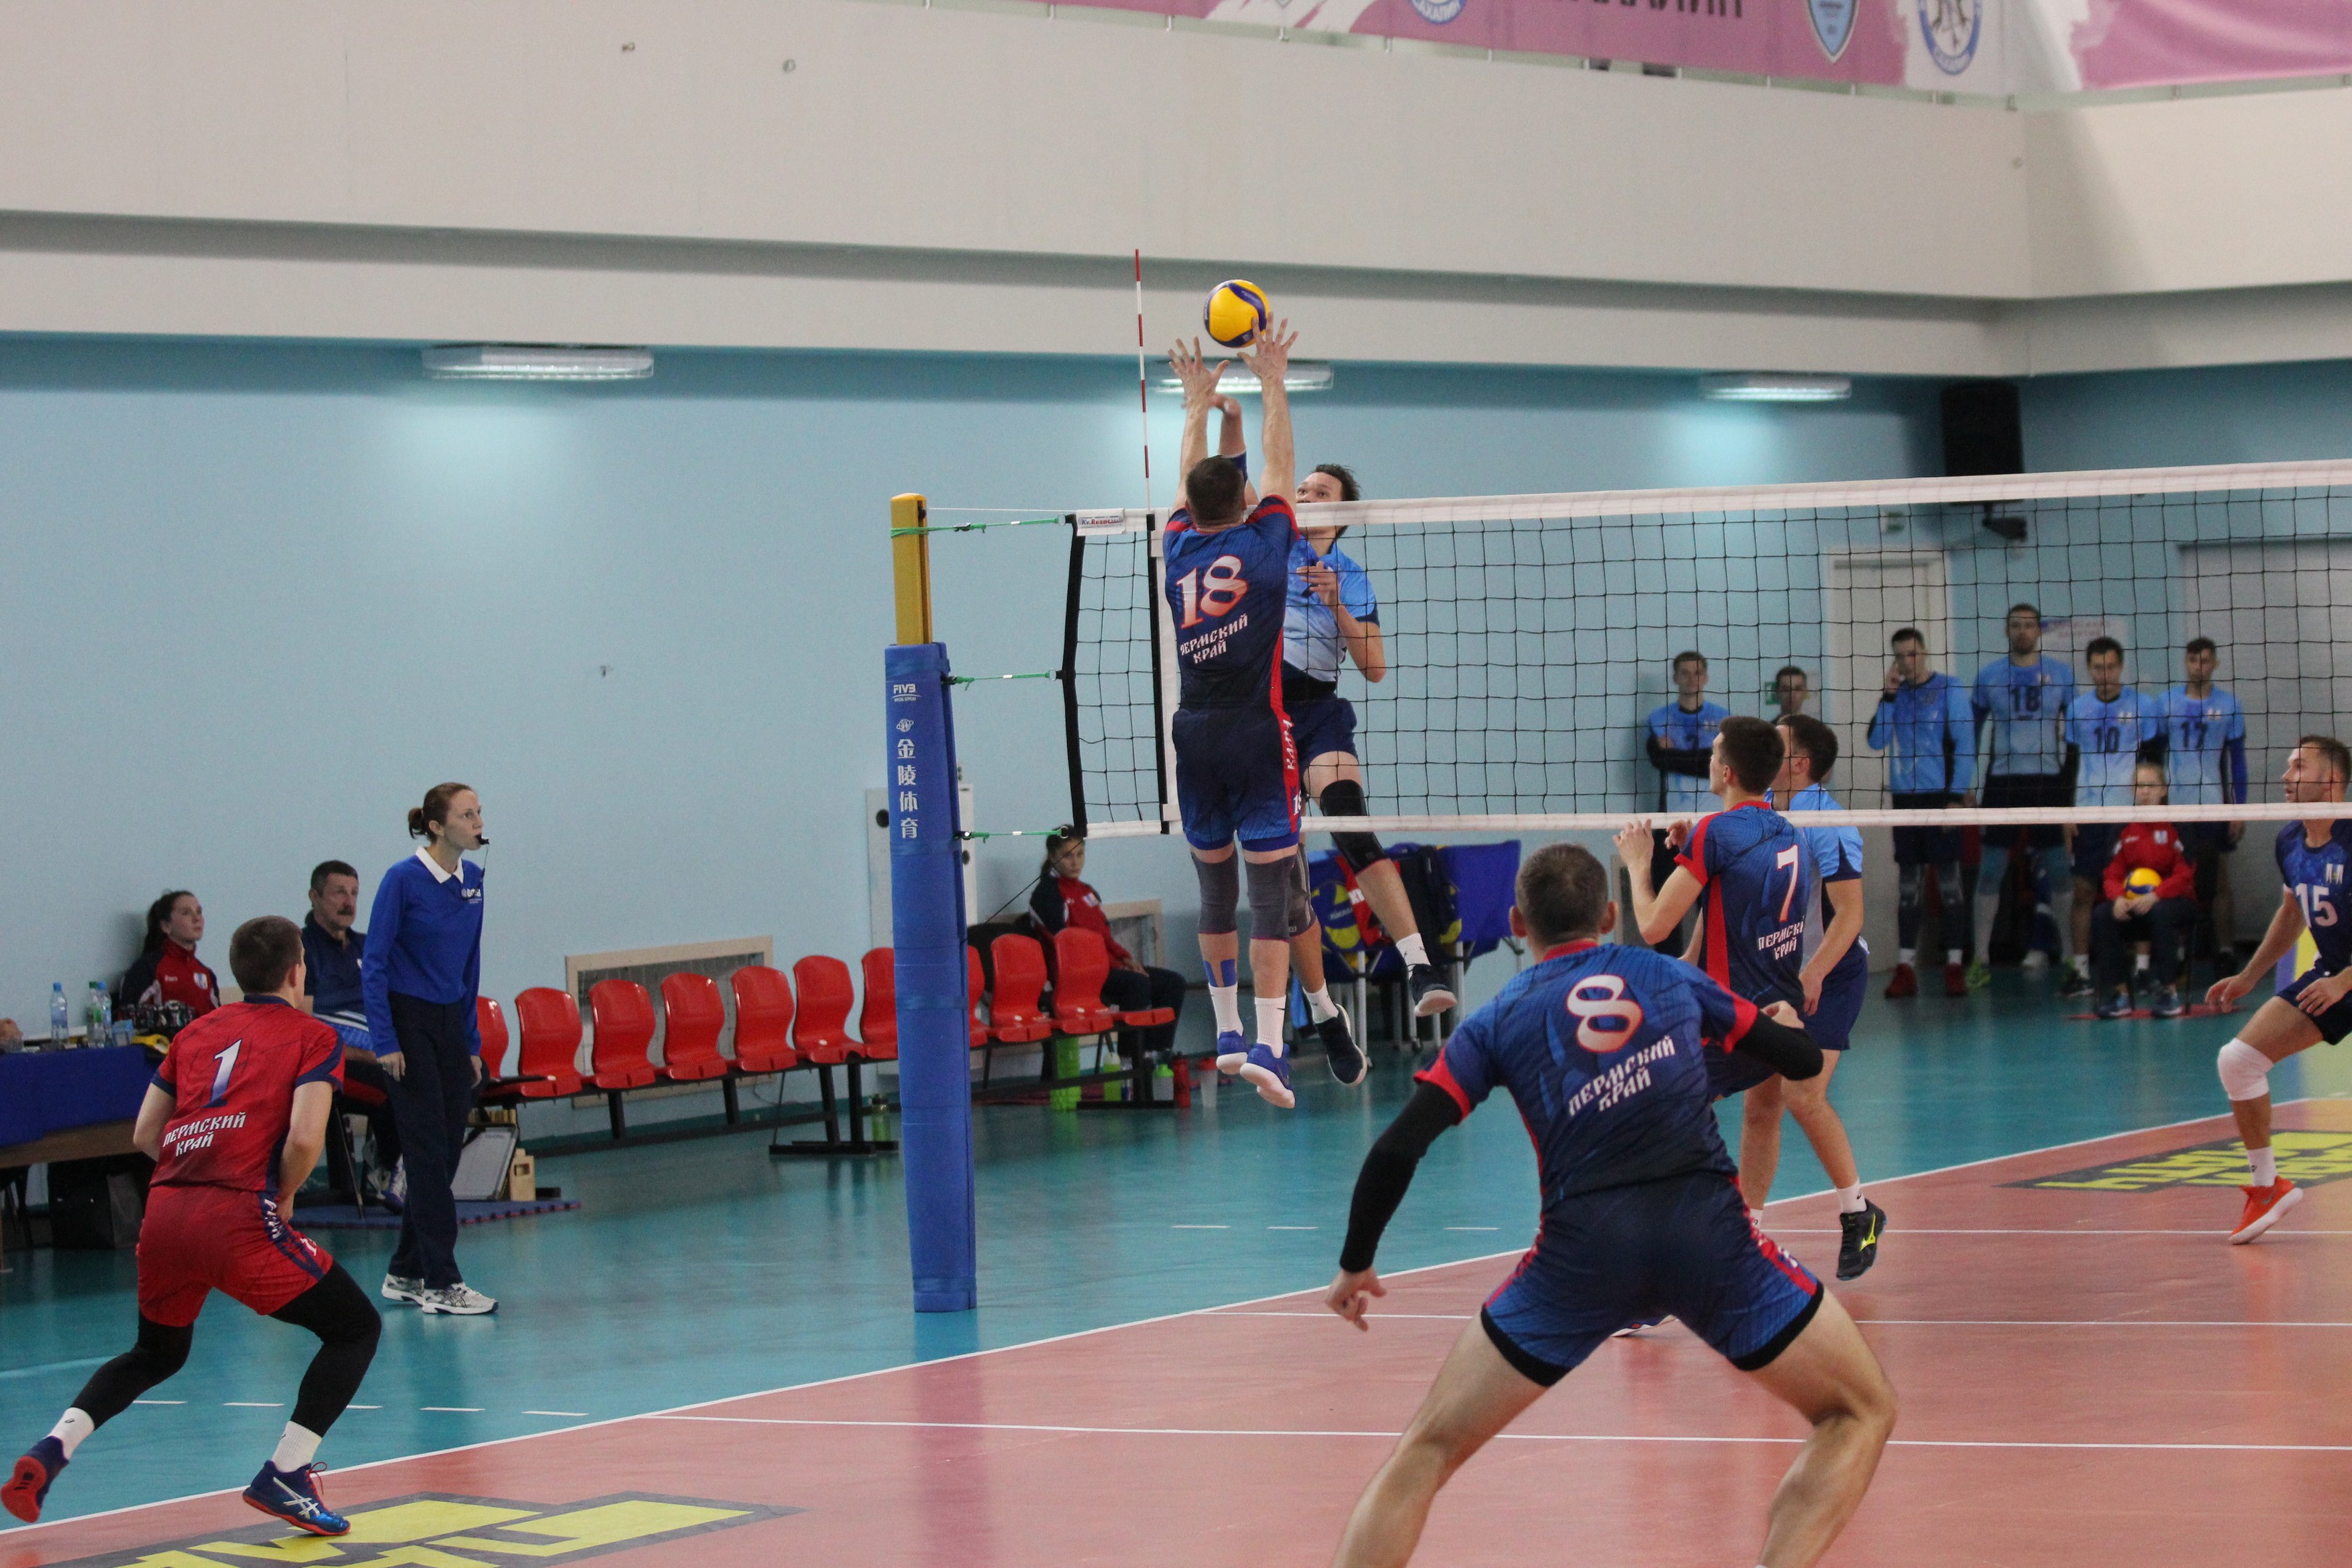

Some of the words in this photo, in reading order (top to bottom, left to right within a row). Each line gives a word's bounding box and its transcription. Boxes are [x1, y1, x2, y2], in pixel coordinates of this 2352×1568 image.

[1176, 555, 1249, 629] 18
[1193, 640, 1227, 663] КРАЙ
[894, 684, 916, 694] FIVB
[2094, 726, 2120, 754] 10
[2181, 722, 2208, 749] 17
[897, 738, 918, 838] 金陵体育
[1776, 844, 1799, 922] 7
[2295, 883, 2338, 928] 15
[1758, 921, 1805, 950] ПЕРМСК
[1774, 936, 1797, 960] КРАЙ
[1566, 973, 1644, 1053] 8
[201, 1038, 242, 1108] 1
[1568, 1034, 1676, 1116] ПЕРМСКИЙ
[1598, 1066, 1651, 1111] КРАЙ
[163, 1111, 247, 1147] ПЕРМСКИЙ
[176, 1131, 214, 1156] КРАЙ
